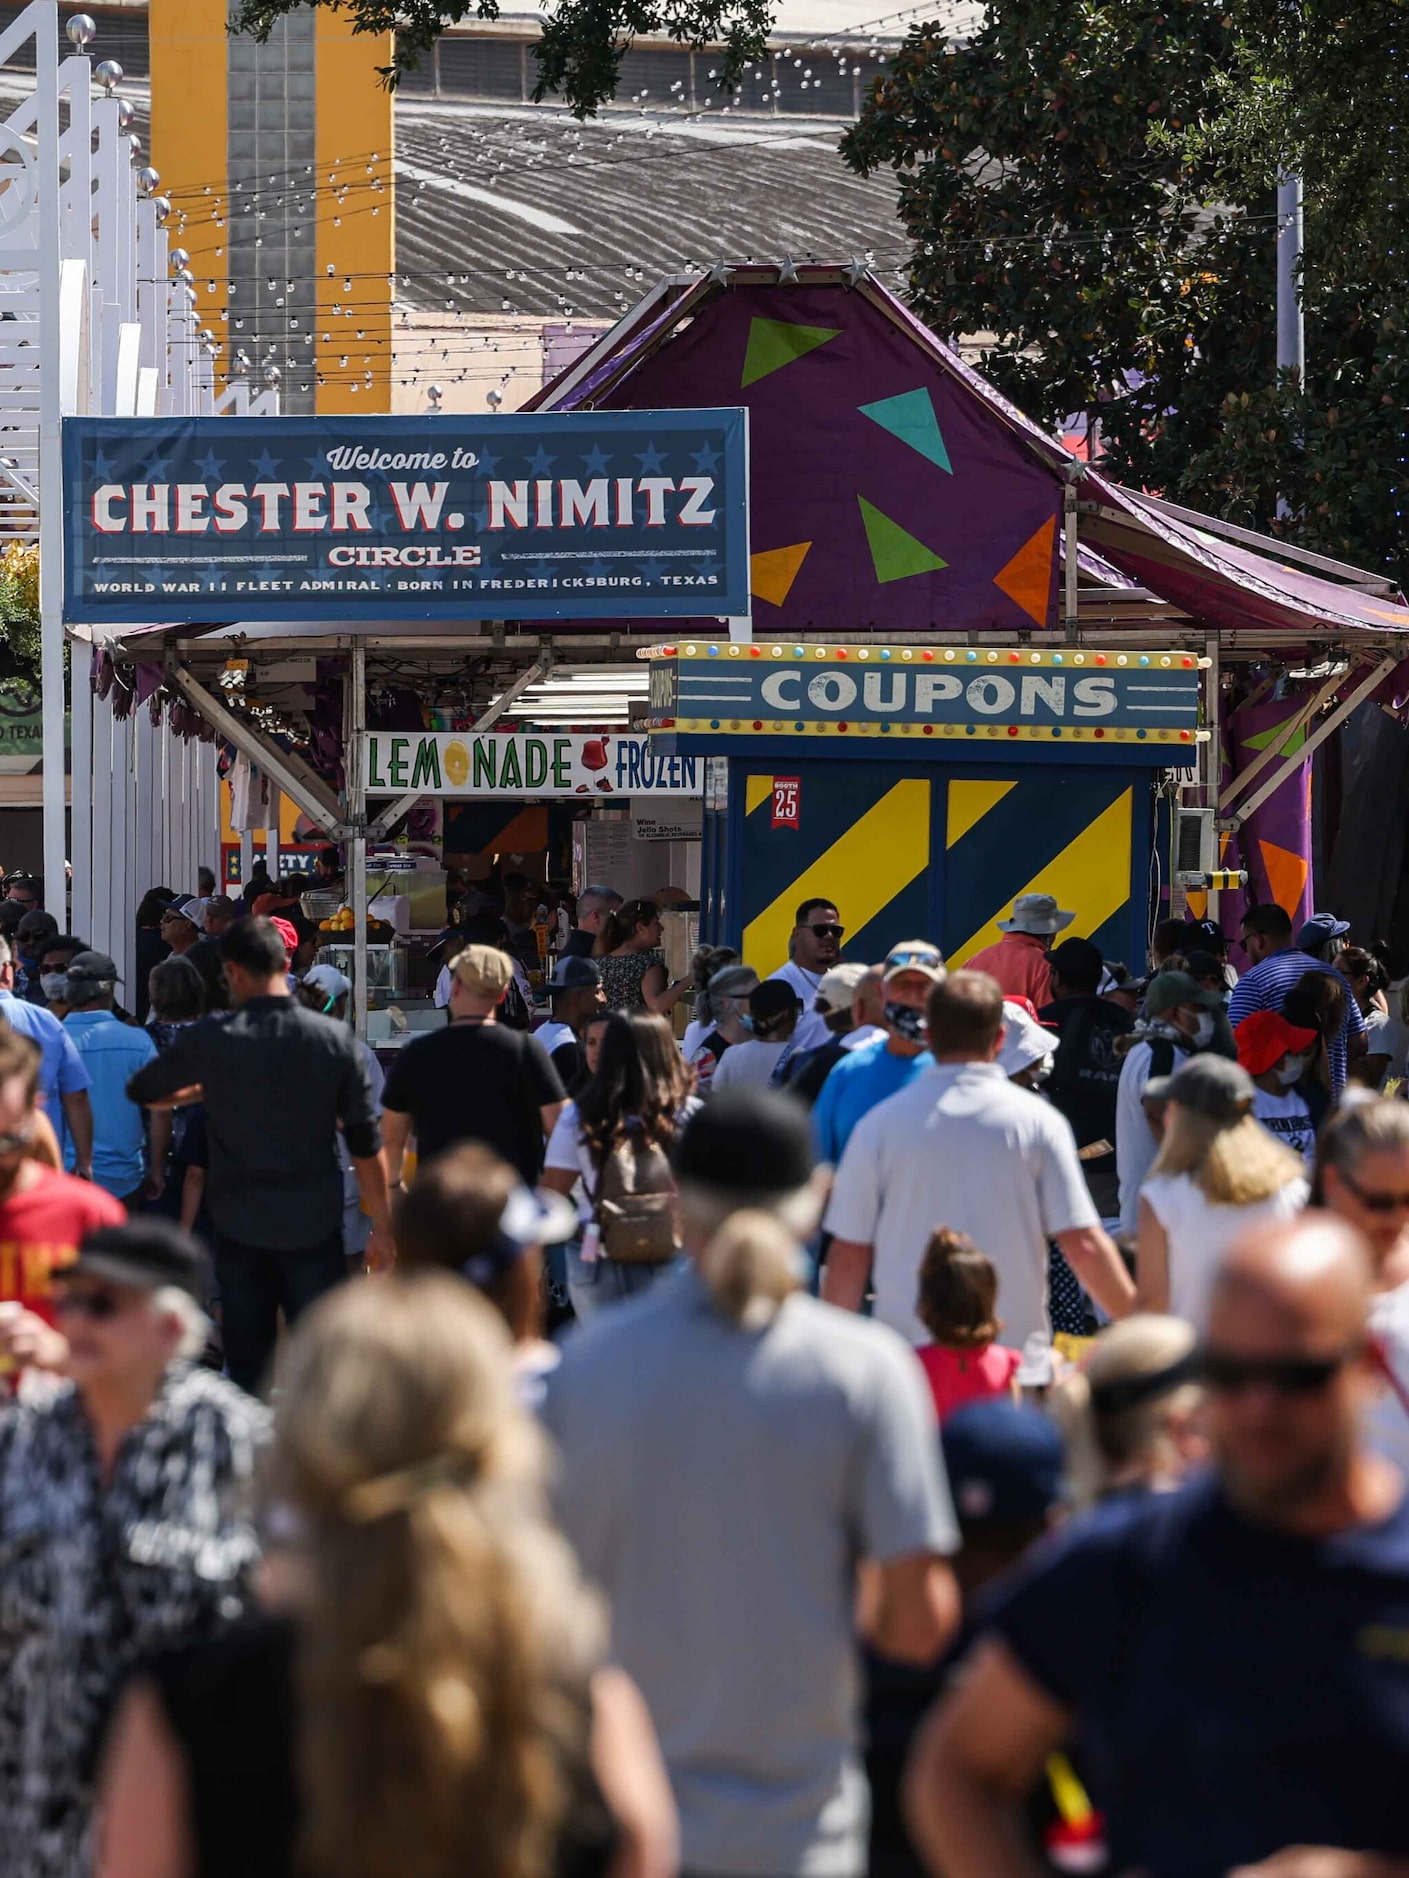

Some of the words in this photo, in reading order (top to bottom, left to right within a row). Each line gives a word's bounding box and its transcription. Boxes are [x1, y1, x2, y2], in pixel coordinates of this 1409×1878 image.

[326, 446, 448, 471] Welcome
[451, 447, 480, 470] to
[91, 482, 373, 534] CHESTER
[388, 481, 465, 531] W.
[487, 476, 717, 531] NIMITZ
[328, 545, 481, 568] CIRCLE
[94, 582, 156, 593] WORLD
[162, 582, 200, 593] WAR
[237, 580, 294, 592] FLEET
[299, 580, 381, 591] ADMIRAL
[397, 579, 443, 591] BORN
[453, 579, 473, 590] IN
[480, 576, 651, 589] FREDERICKSBURG,
[660, 575, 719, 586] TEXAS
[760, 670, 1118, 717] COUPONS
[10, 725, 43, 739] TEXA
[615, 740, 697, 790] FROZEN
[775, 790, 797, 817] 25
[637, 826, 657, 834] Jello
[1201, 921, 1215, 935] T
